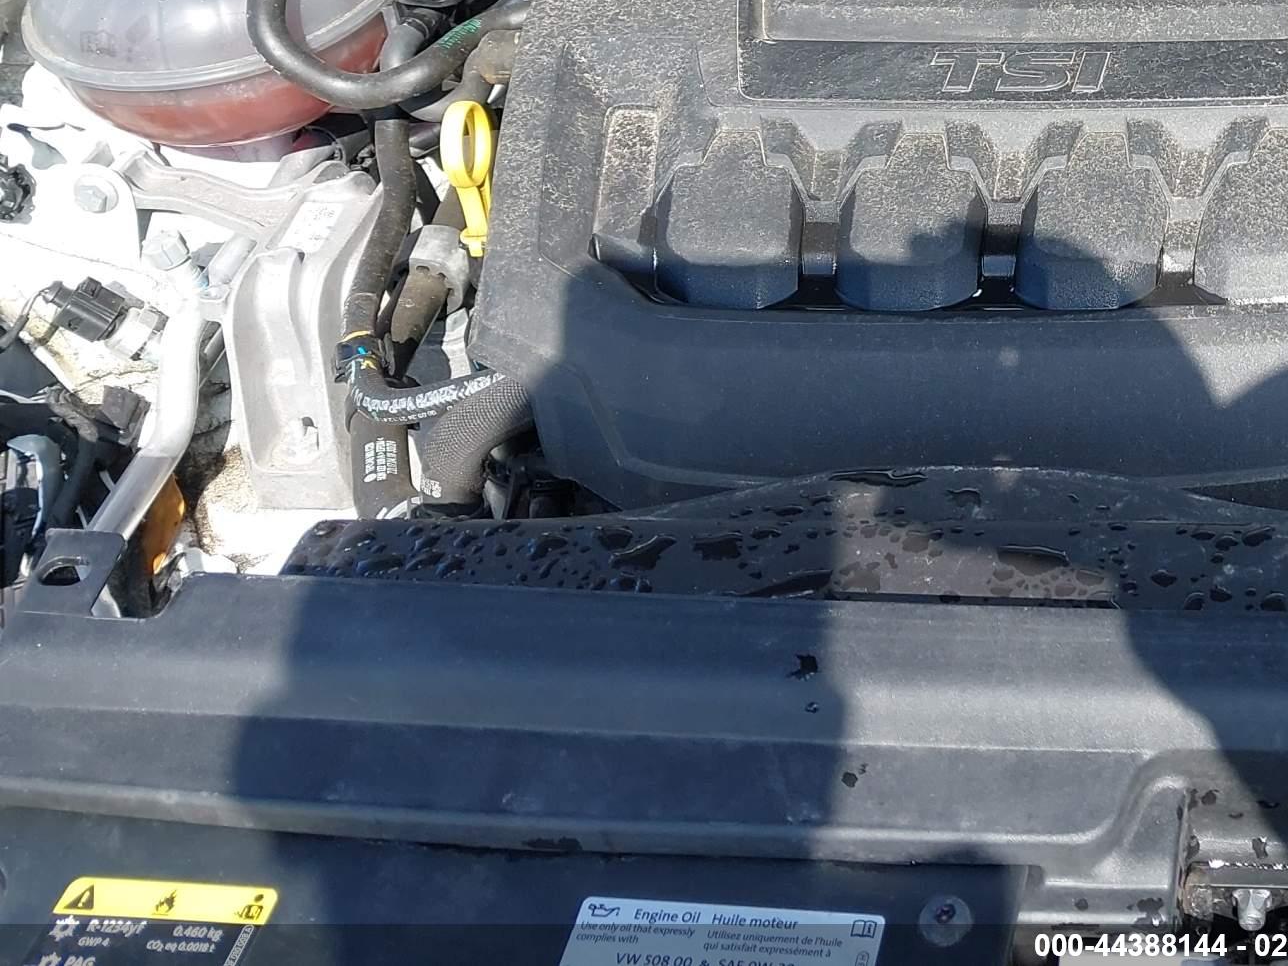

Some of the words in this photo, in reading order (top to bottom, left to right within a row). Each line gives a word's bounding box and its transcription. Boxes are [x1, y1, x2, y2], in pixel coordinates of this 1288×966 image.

[929, 51, 1111, 92] TSI
[634, 908, 679, 924] Engine
[681, 910, 701, 923] Oil
[711, 912, 746, 927] Huile
[749, 917, 799, 930] moteur
[86, 918, 147, 938] R-1234yf
[172, 925, 207, 938] 0.460
[206, 929, 224, 942] kg
[580, 921, 597, 930] Use
[598, 922, 618, 933] only
[619, 923, 631, 932] oil
[633, 924, 652, 934] that
[653, 926, 696, 938] expressly
[78, 936, 101, 947] GWP
[576, 933, 616, 945] complies
[617, 934, 639, 944] with
[707, 929, 741, 941] Utilisez
[743, 933, 799, 947] uniquement
[801, 936, 812, 946] de
[164, 942, 178, 953] eq
[703, 942, 720, 952] qui
[720, 942, 758, 954] satisfait
[759, 945, 824, 959] expressément
[64, 955, 97, 966] PAG
[615, 952, 642, 965] VW
[643, 953, 670, 966] 508
[673, 955, 693, 966] 00
